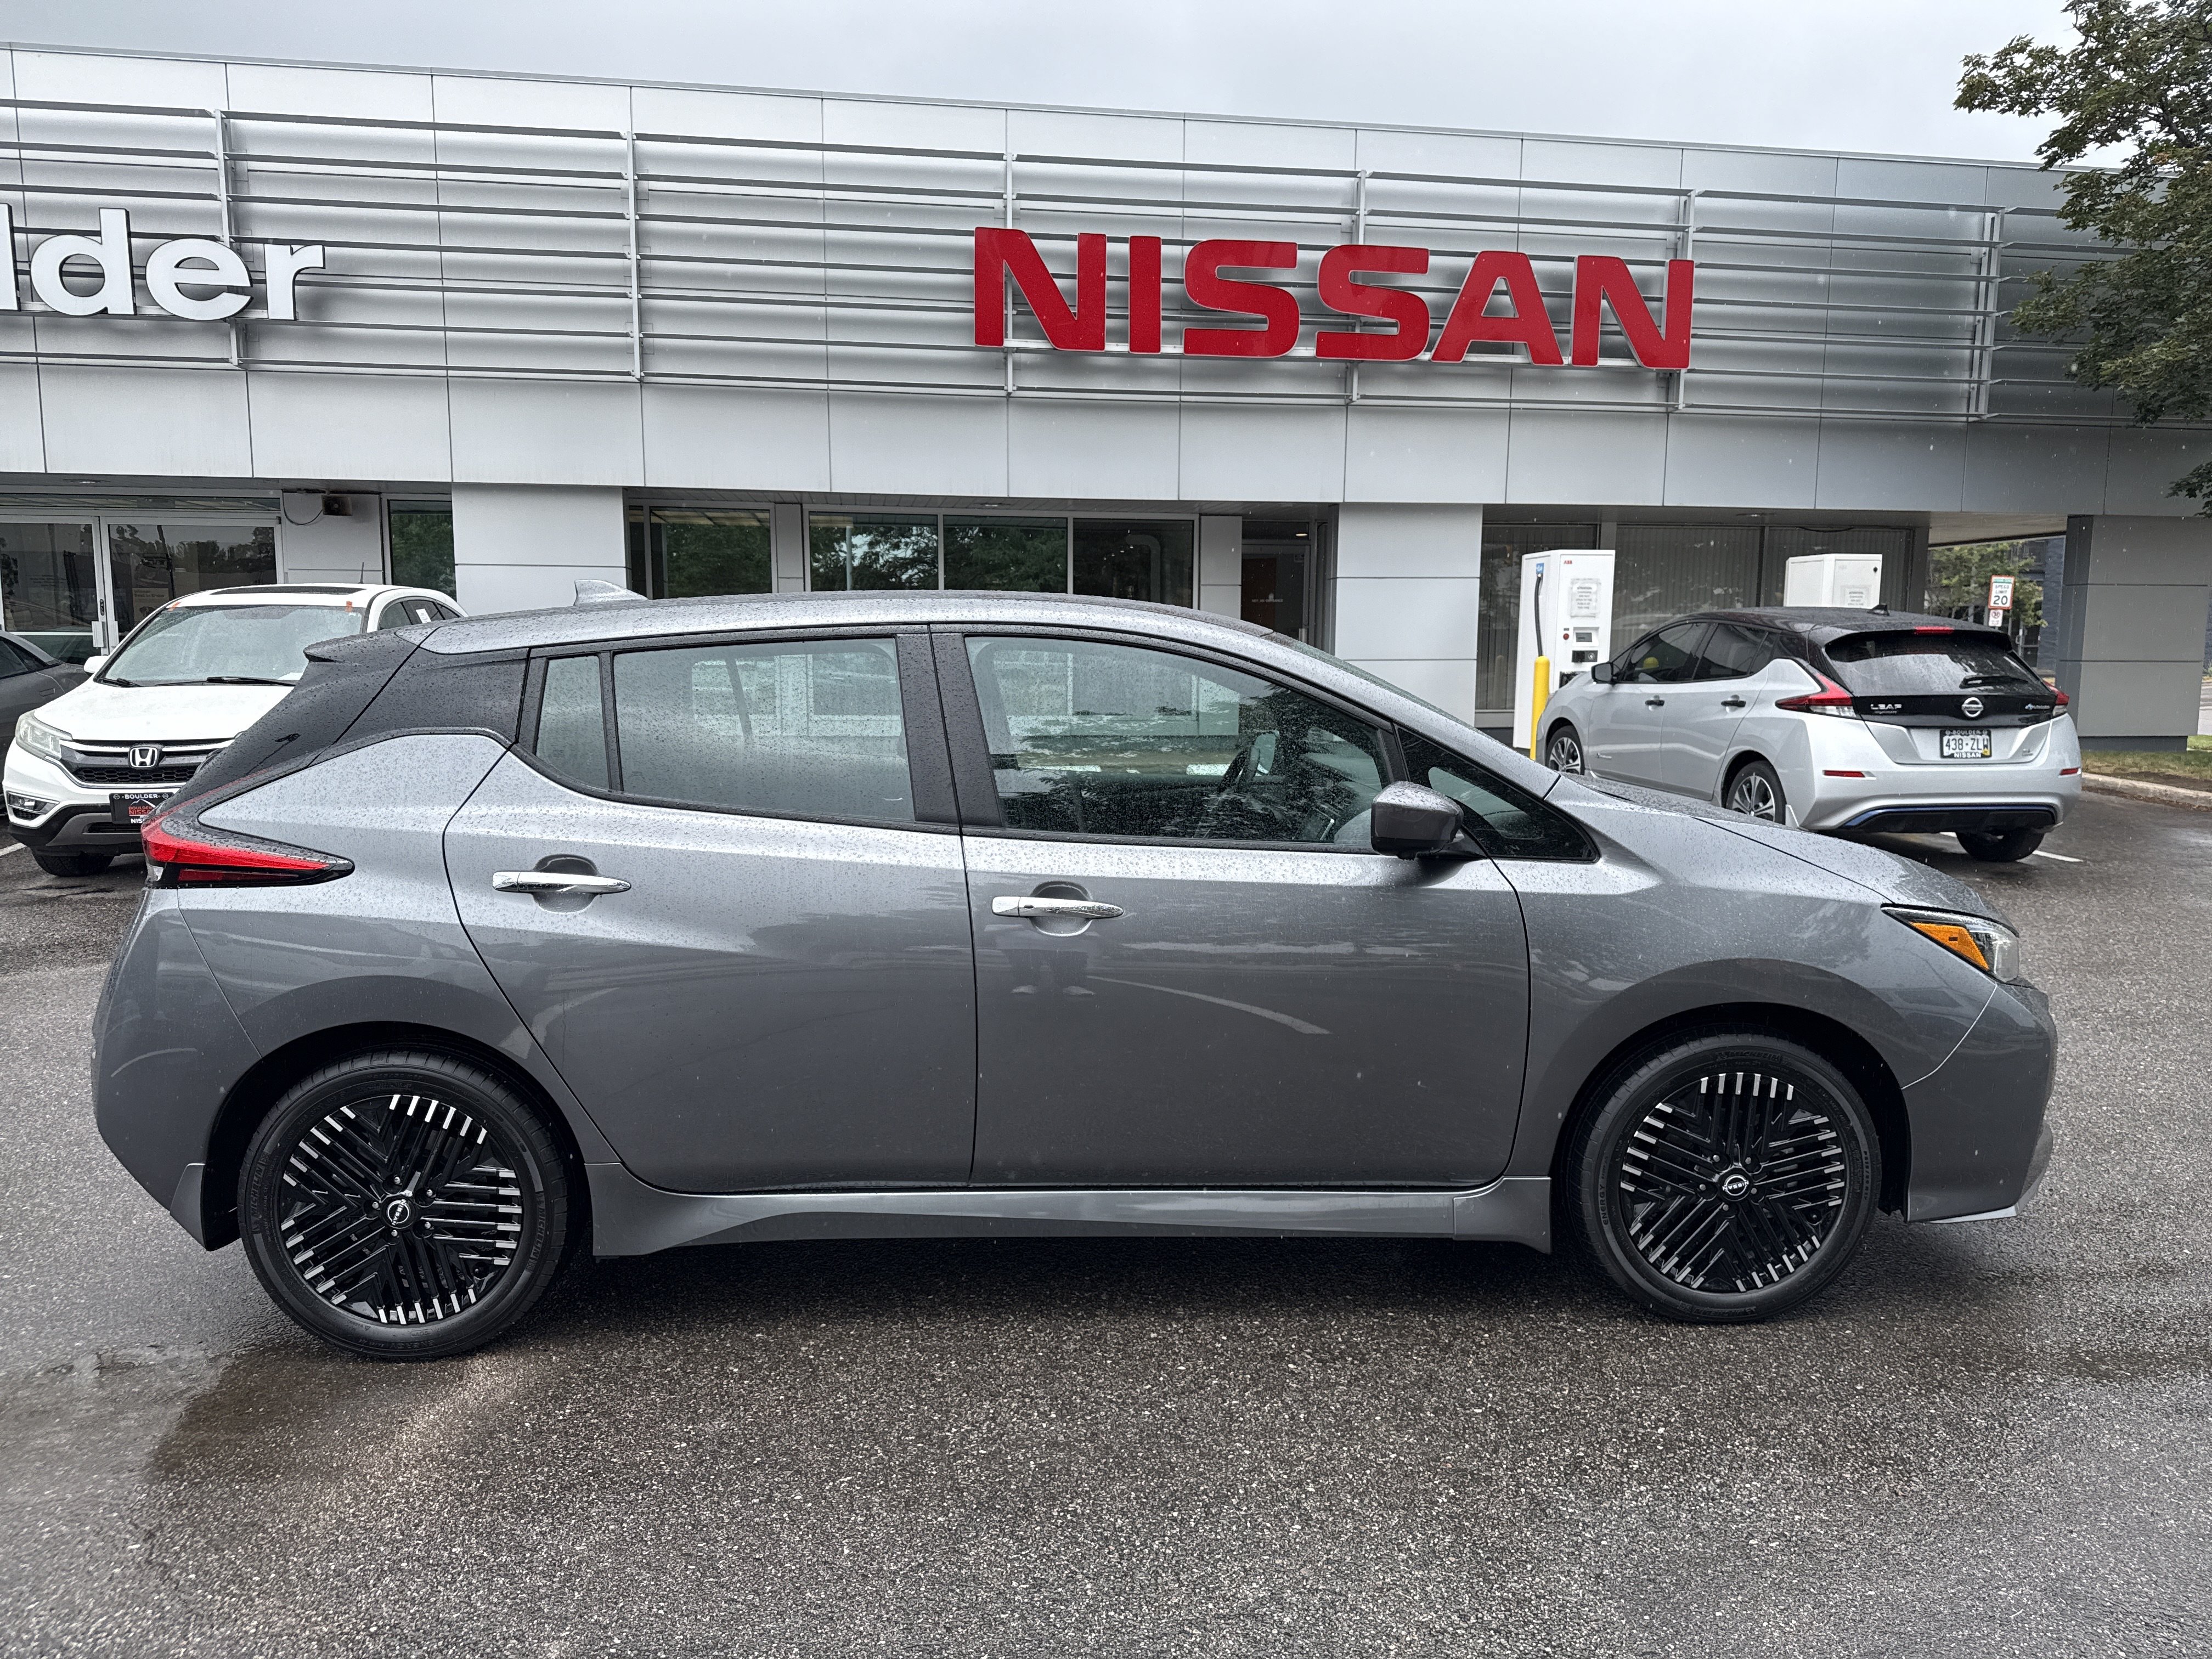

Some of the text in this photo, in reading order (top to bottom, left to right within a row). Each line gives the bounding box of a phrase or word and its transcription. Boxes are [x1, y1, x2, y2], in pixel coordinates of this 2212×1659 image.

[974, 227, 1695, 369] NISSAN
[1993, 595, 2008, 605] 20
[1723, 1180, 1749, 1191] NISSAN
[391, 1199, 407, 1226] NISSAN
[1599, 1184, 1609, 1225] ENERGY
[532, 1207, 545, 1257] MICHELIN
